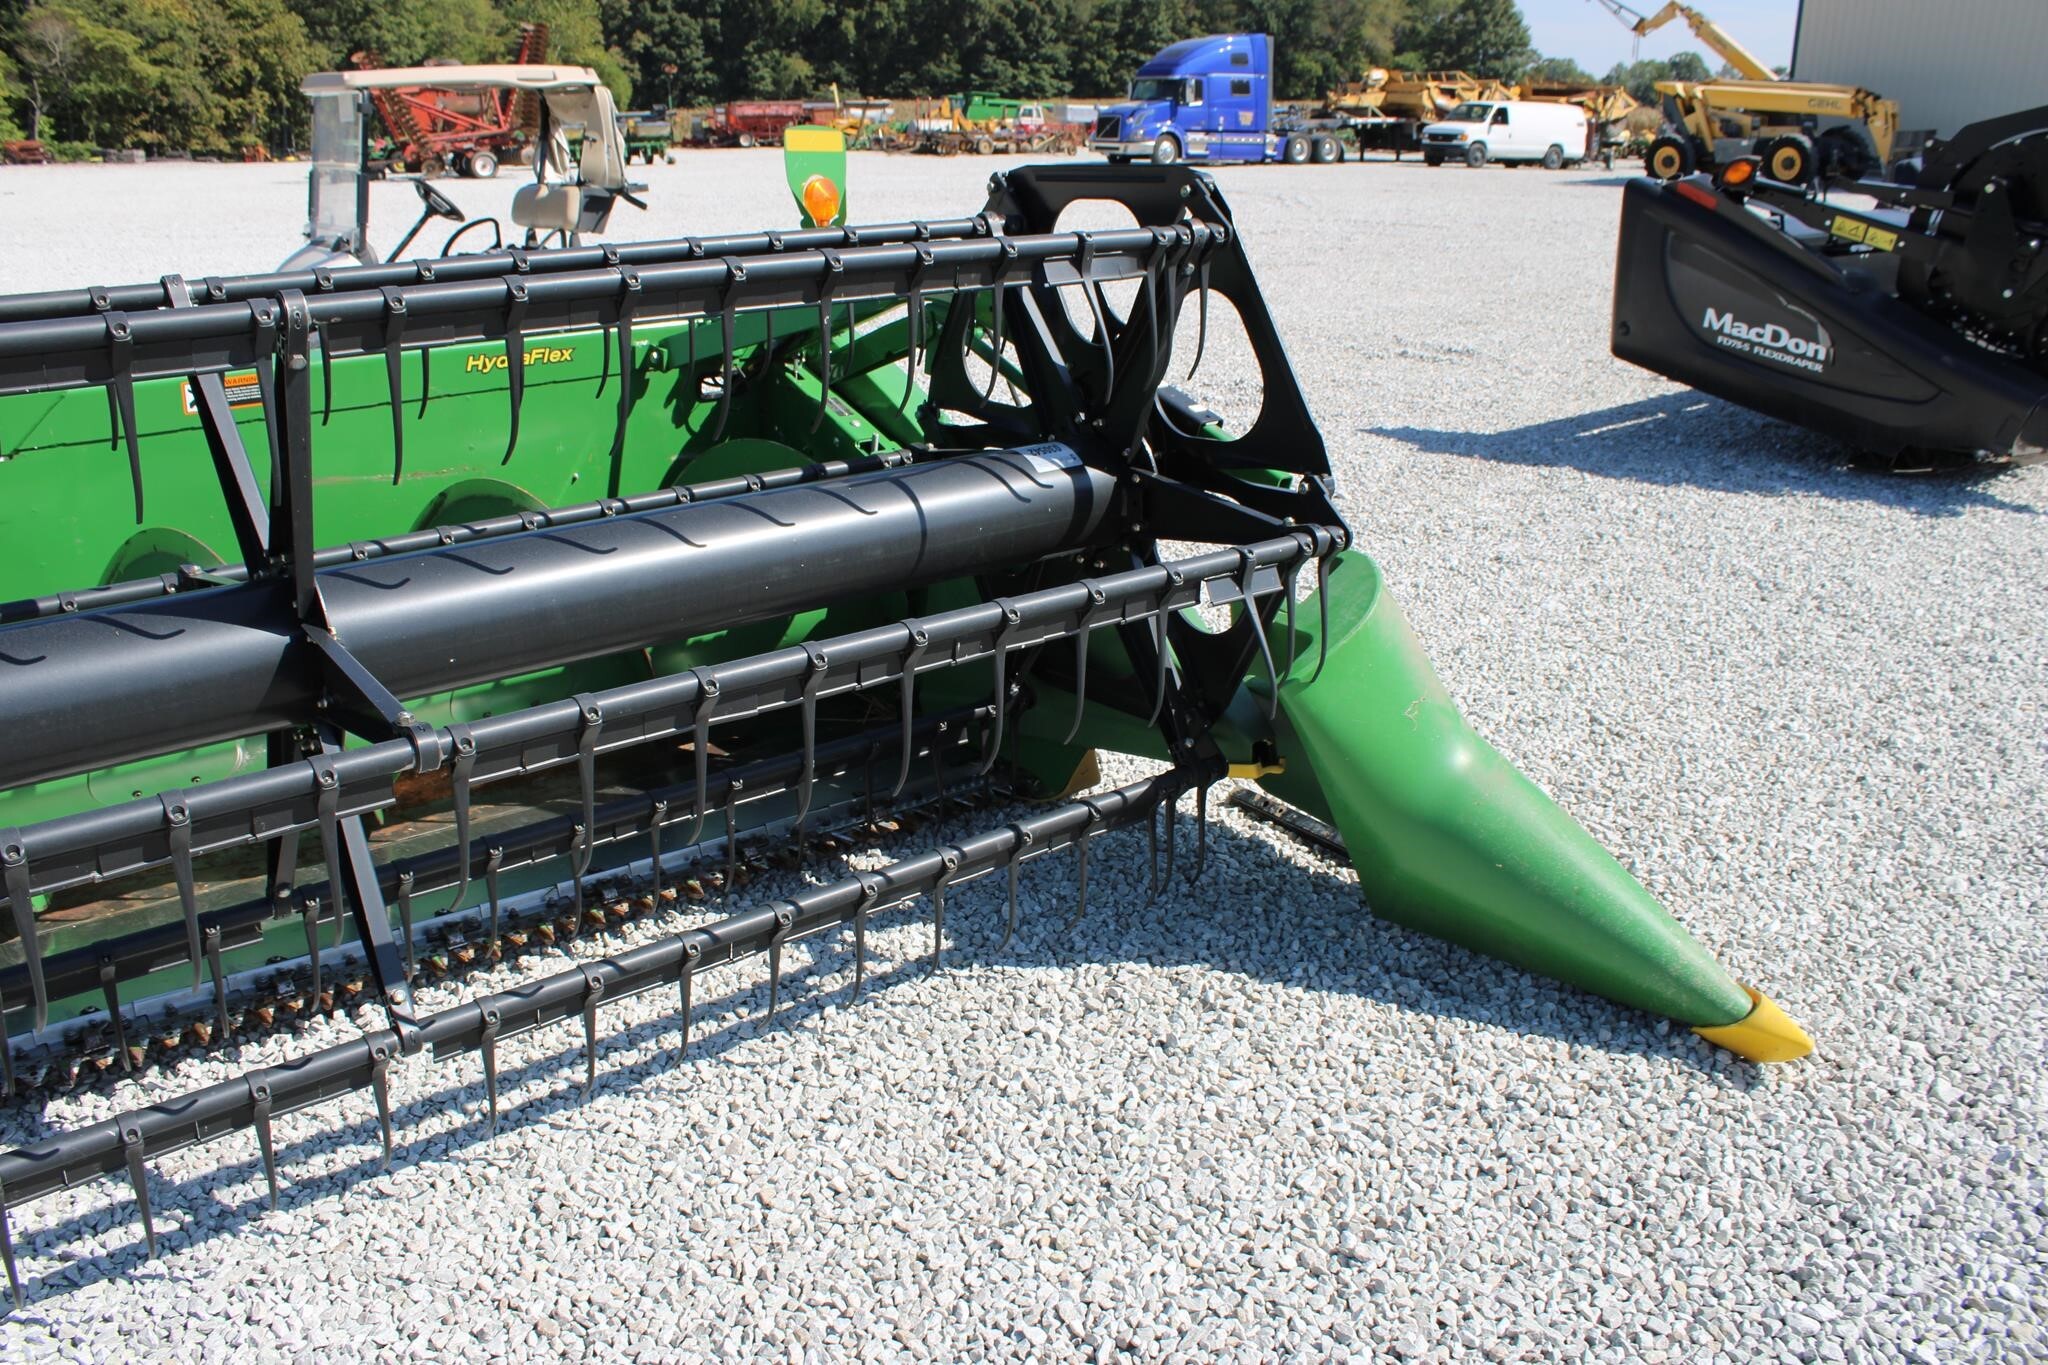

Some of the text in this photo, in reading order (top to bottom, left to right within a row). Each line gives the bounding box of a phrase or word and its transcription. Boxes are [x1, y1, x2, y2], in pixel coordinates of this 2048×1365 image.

[1703, 307, 1827, 361] MacDon
[466, 347, 574, 373] HydaFlex
[1753, 346, 1824, 373] FLEXDRAPER
[224, 374, 259, 387] WARNIN
